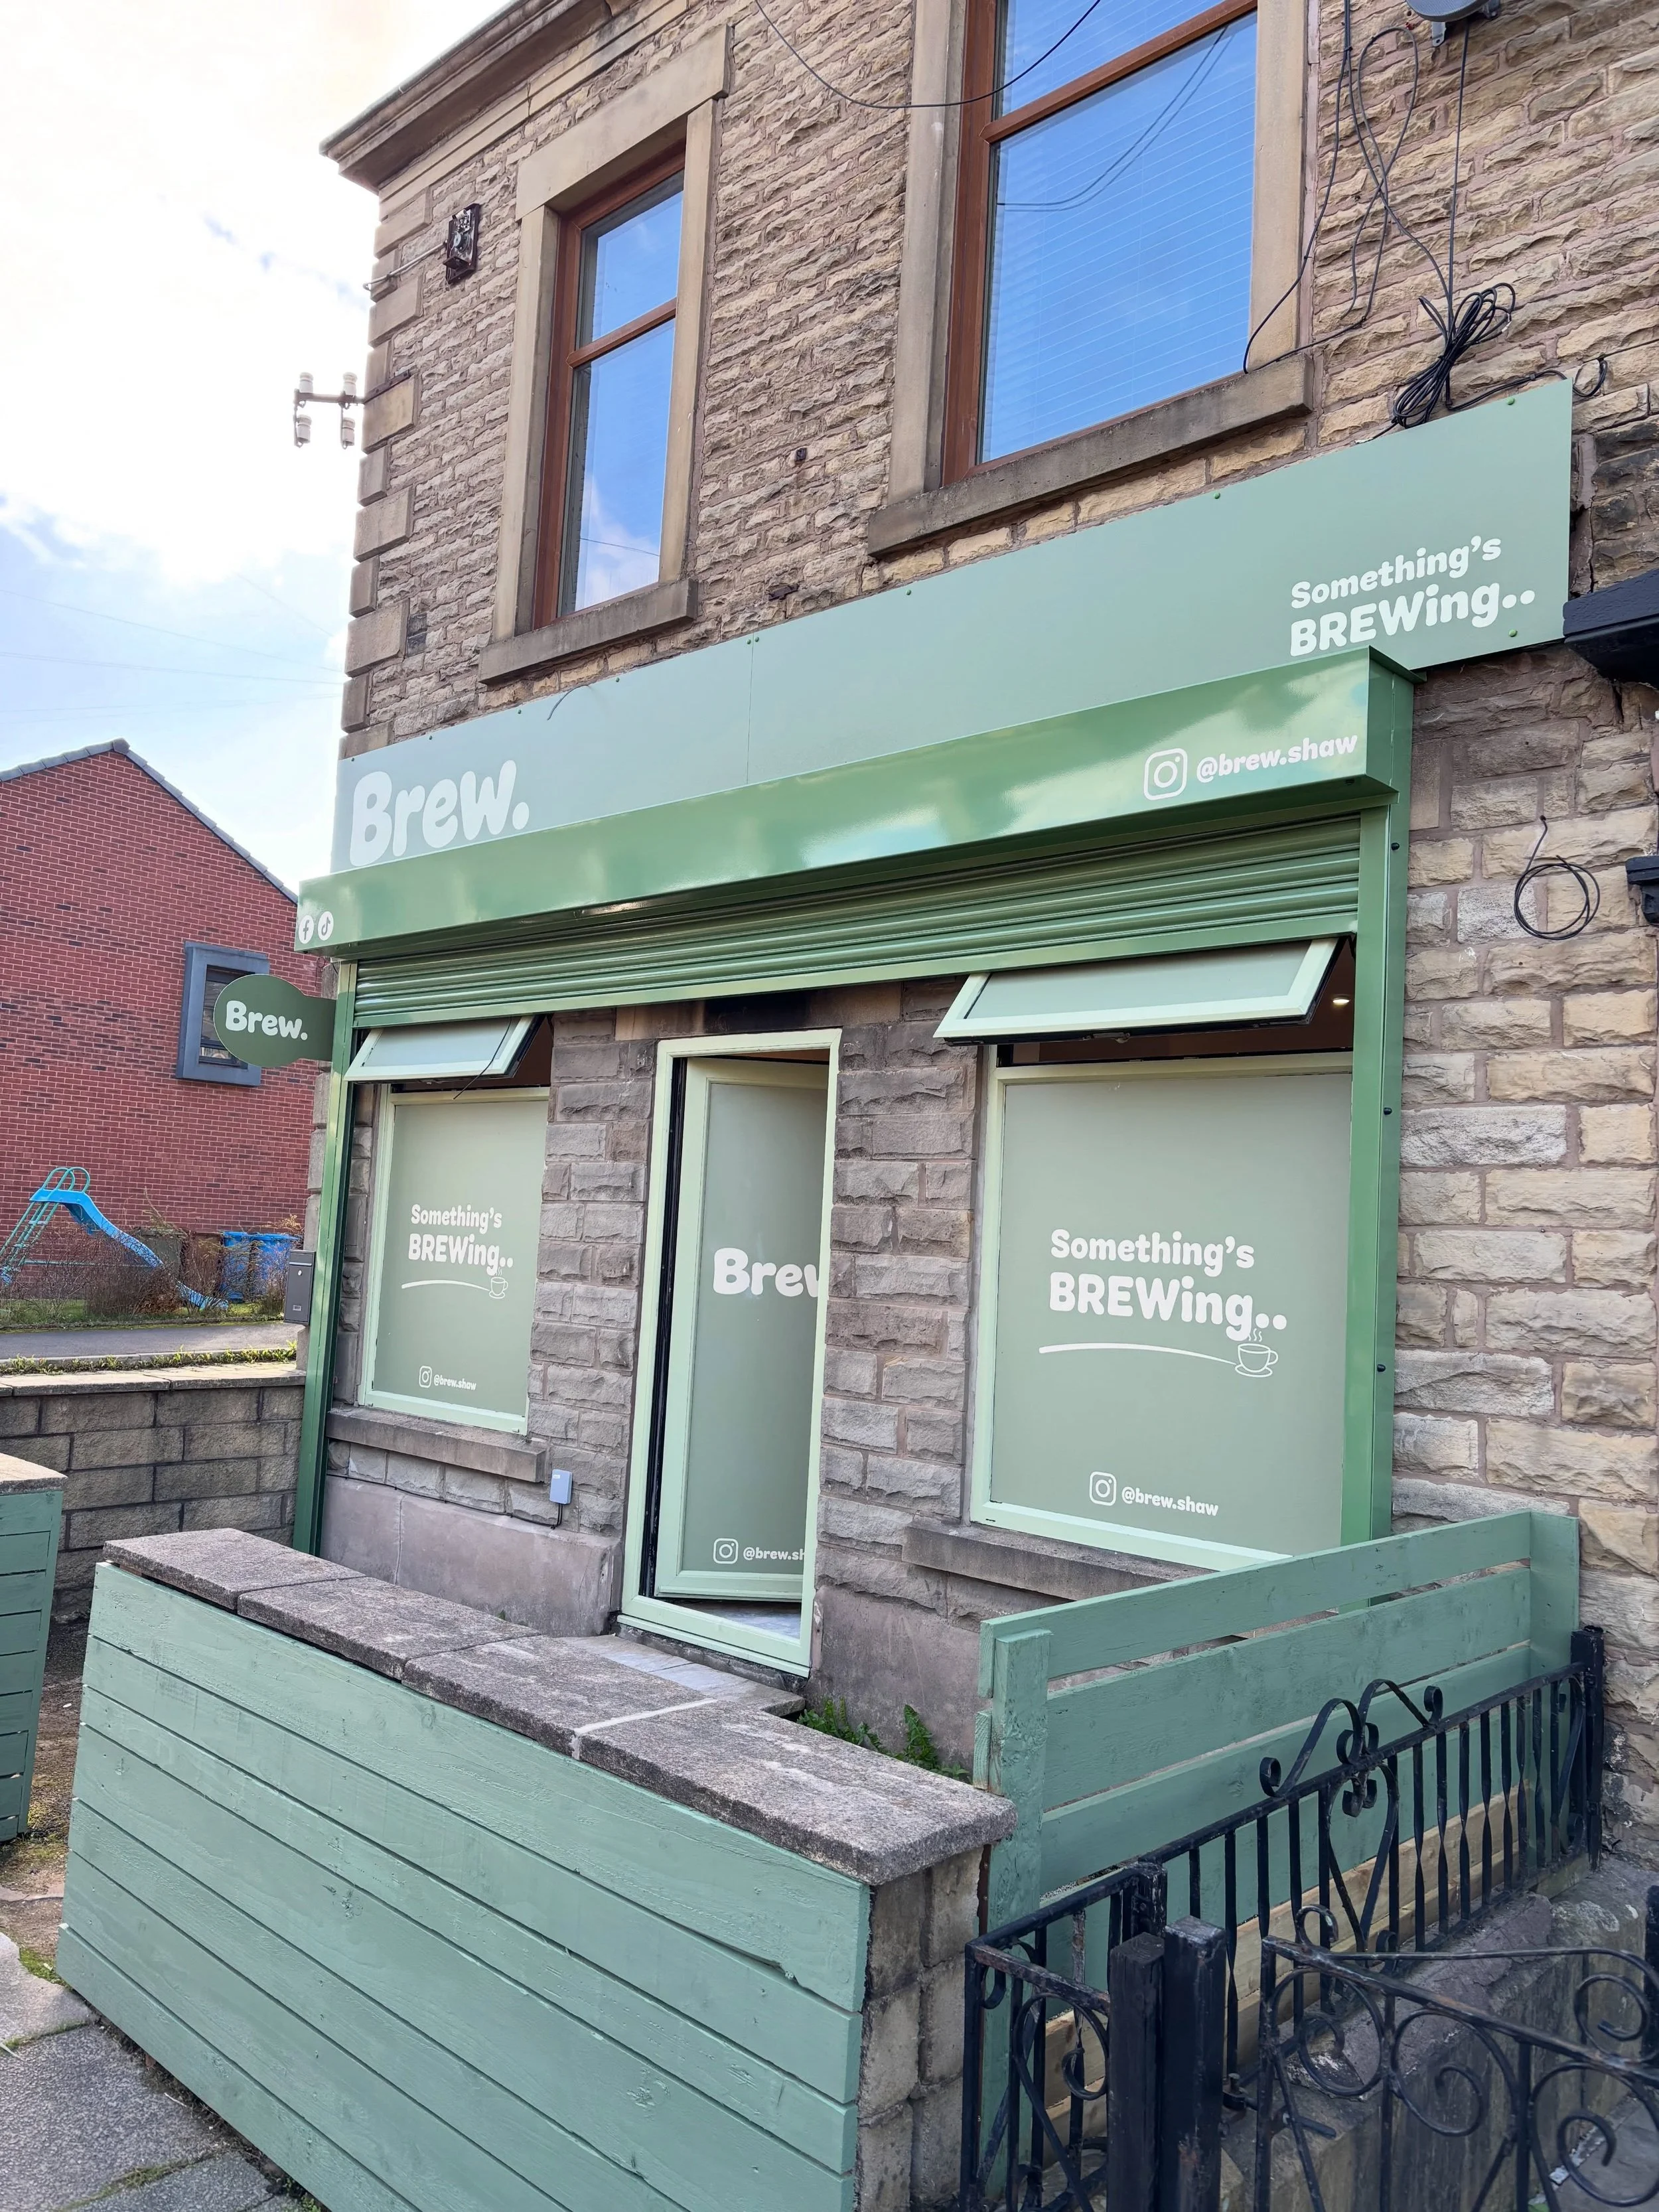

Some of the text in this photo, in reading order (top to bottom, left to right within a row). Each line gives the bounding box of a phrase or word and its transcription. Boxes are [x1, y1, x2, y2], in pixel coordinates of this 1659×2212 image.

[1290, 535, 1502, 609] Something’s
[1289, 582, 1536, 657] BREWing..
[1196, 735, 1358, 782] @brew.shaw
[349, 759, 530, 867] Brew.
[225, 999, 308, 1041] Brew.
[411, 1204, 502, 1234] Something’s
[407, 1232, 514, 1276] BREWing..
[713, 1247, 819, 1298] Bre
[1050, 1228, 1256, 1278] Something’s
[1049, 1271, 1288, 1342] BREWing..
[433, 1374, 476, 1390] @brew.shaw
[1121, 1485, 1219, 1516] @brew.shaw
[743, 1546, 805, 1560] @brew.sh
